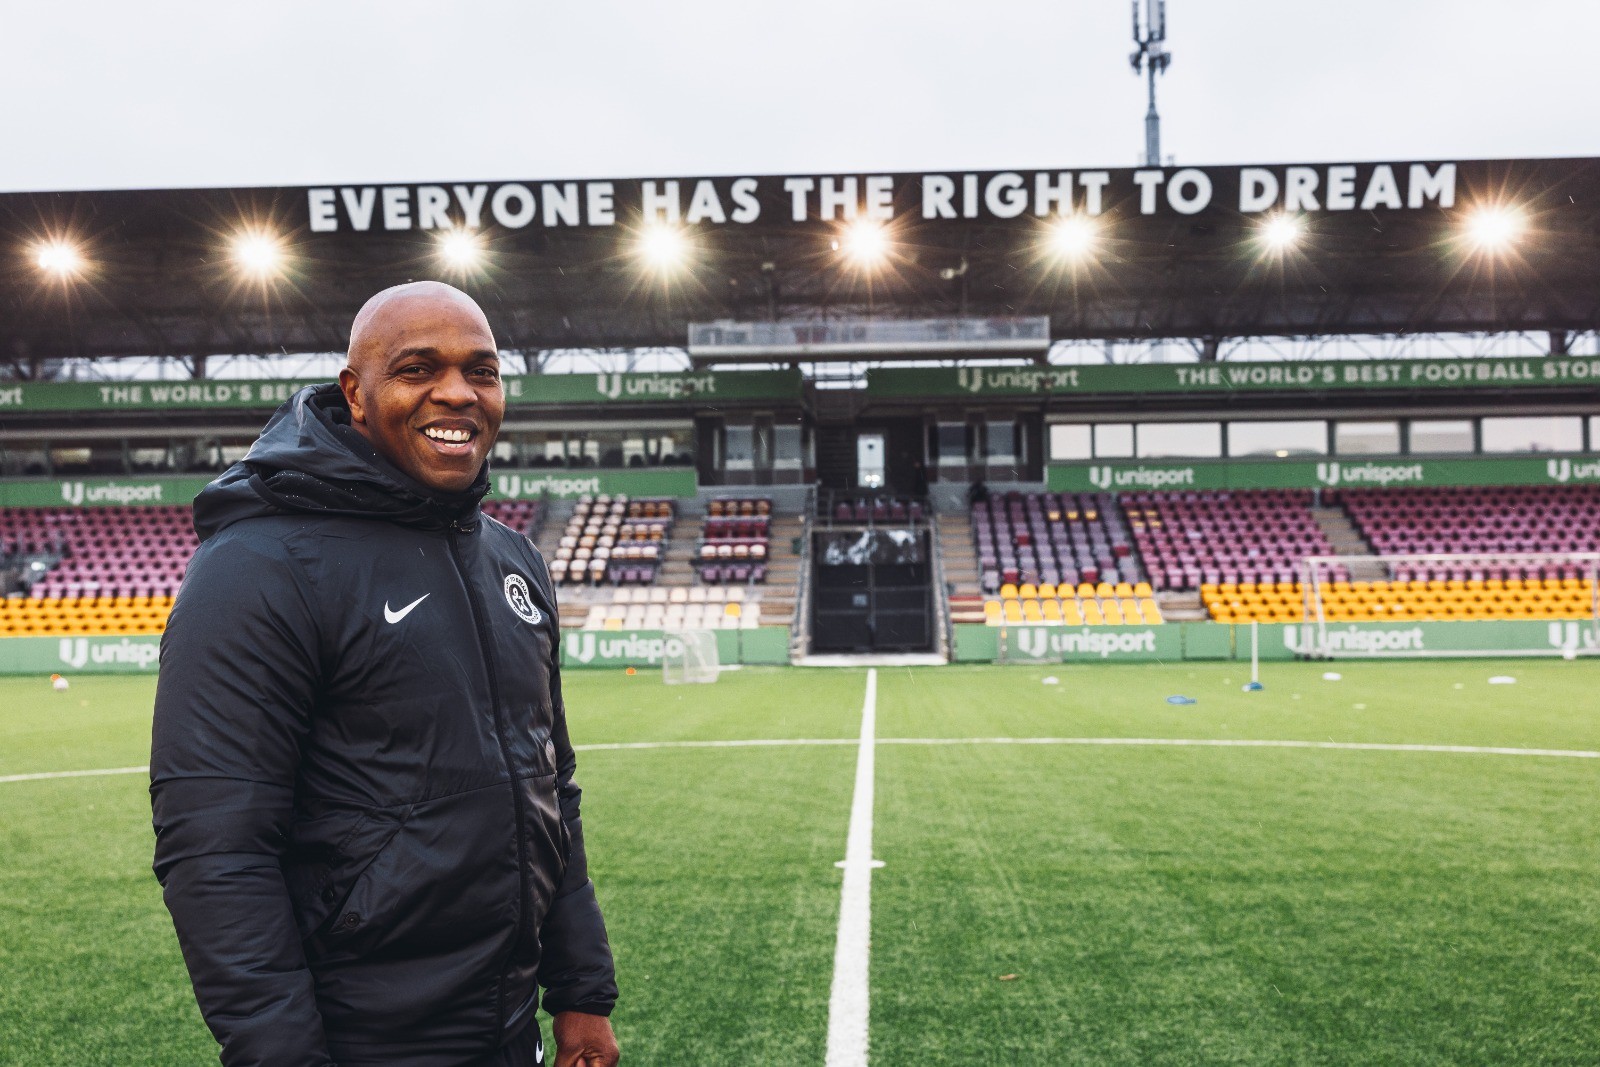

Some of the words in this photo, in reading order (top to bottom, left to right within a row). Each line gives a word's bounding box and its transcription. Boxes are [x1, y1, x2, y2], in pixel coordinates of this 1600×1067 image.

[308, 182, 616, 233] EVERYONE
[641, 177, 761, 225] HAS
[783, 175, 894, 223] THE
[922, 170, 1110, 220] RIGHT
[1133, 168, 1213, 215] TO
[1239, 163, 1456, 213] DREAM
[987, 366, 1078, 393] unisport
[1176, 367, 1220, 386] THE
[1228, 365, 1336, 384] WORLD'S
[1343, 363, 1401, 382] BEST
[1410, 360, 1533, 381] FOOTBALL
[101, 387, 144, 404] THE
[150, 384, 253, 403] WORLD'S
[260, 383, 310, 401] BES
[625, 375, 715, 399] unisport
[523, 475, 599, 497] unisport
[1115, 466, 1194, 488] unisport
[1342, 462, 1424, 486] unisport
[86, 482, 162, 505] unisport
[600, 633, 685, 663] unispo
[1051, 627, 1156, 658] unisport
